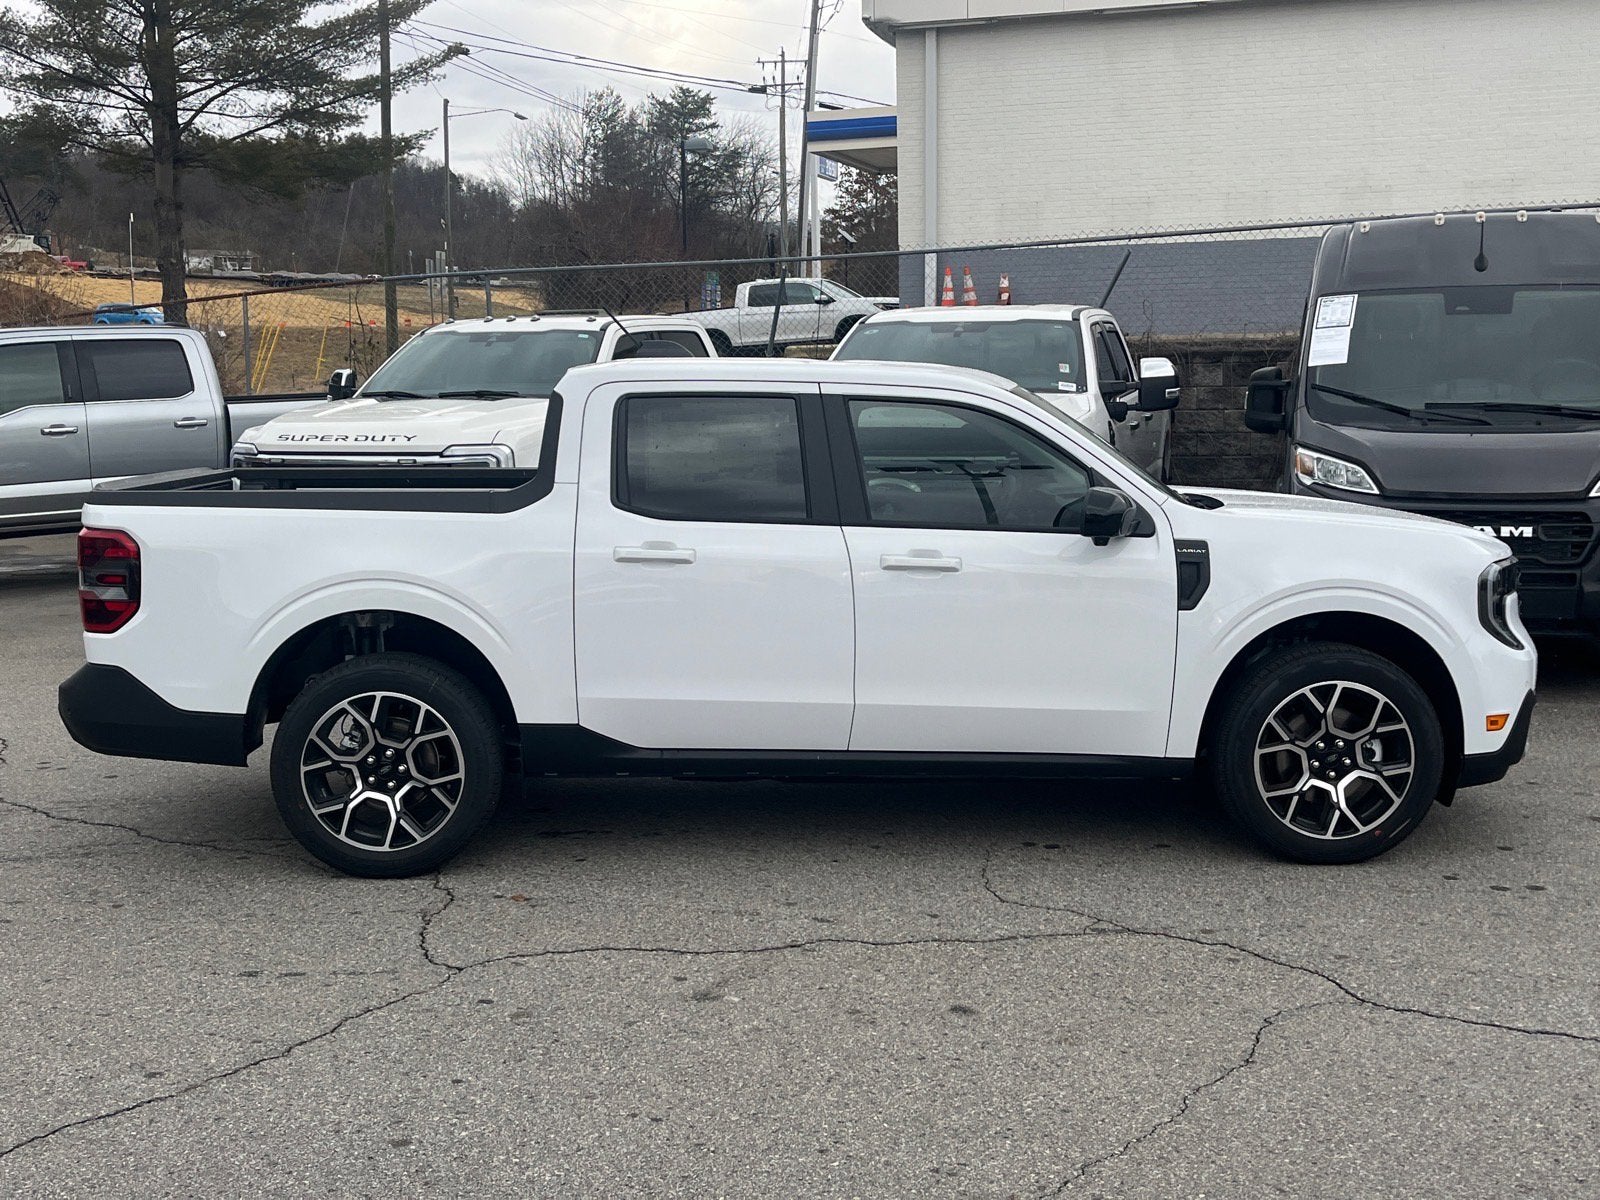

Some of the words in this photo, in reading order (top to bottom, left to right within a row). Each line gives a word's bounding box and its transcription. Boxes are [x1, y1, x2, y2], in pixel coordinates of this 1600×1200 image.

[277, 434, 349, 442] SUPER
[354, 434, 418, 442] DUTY
[1472, 525, 1534, 538] AM
